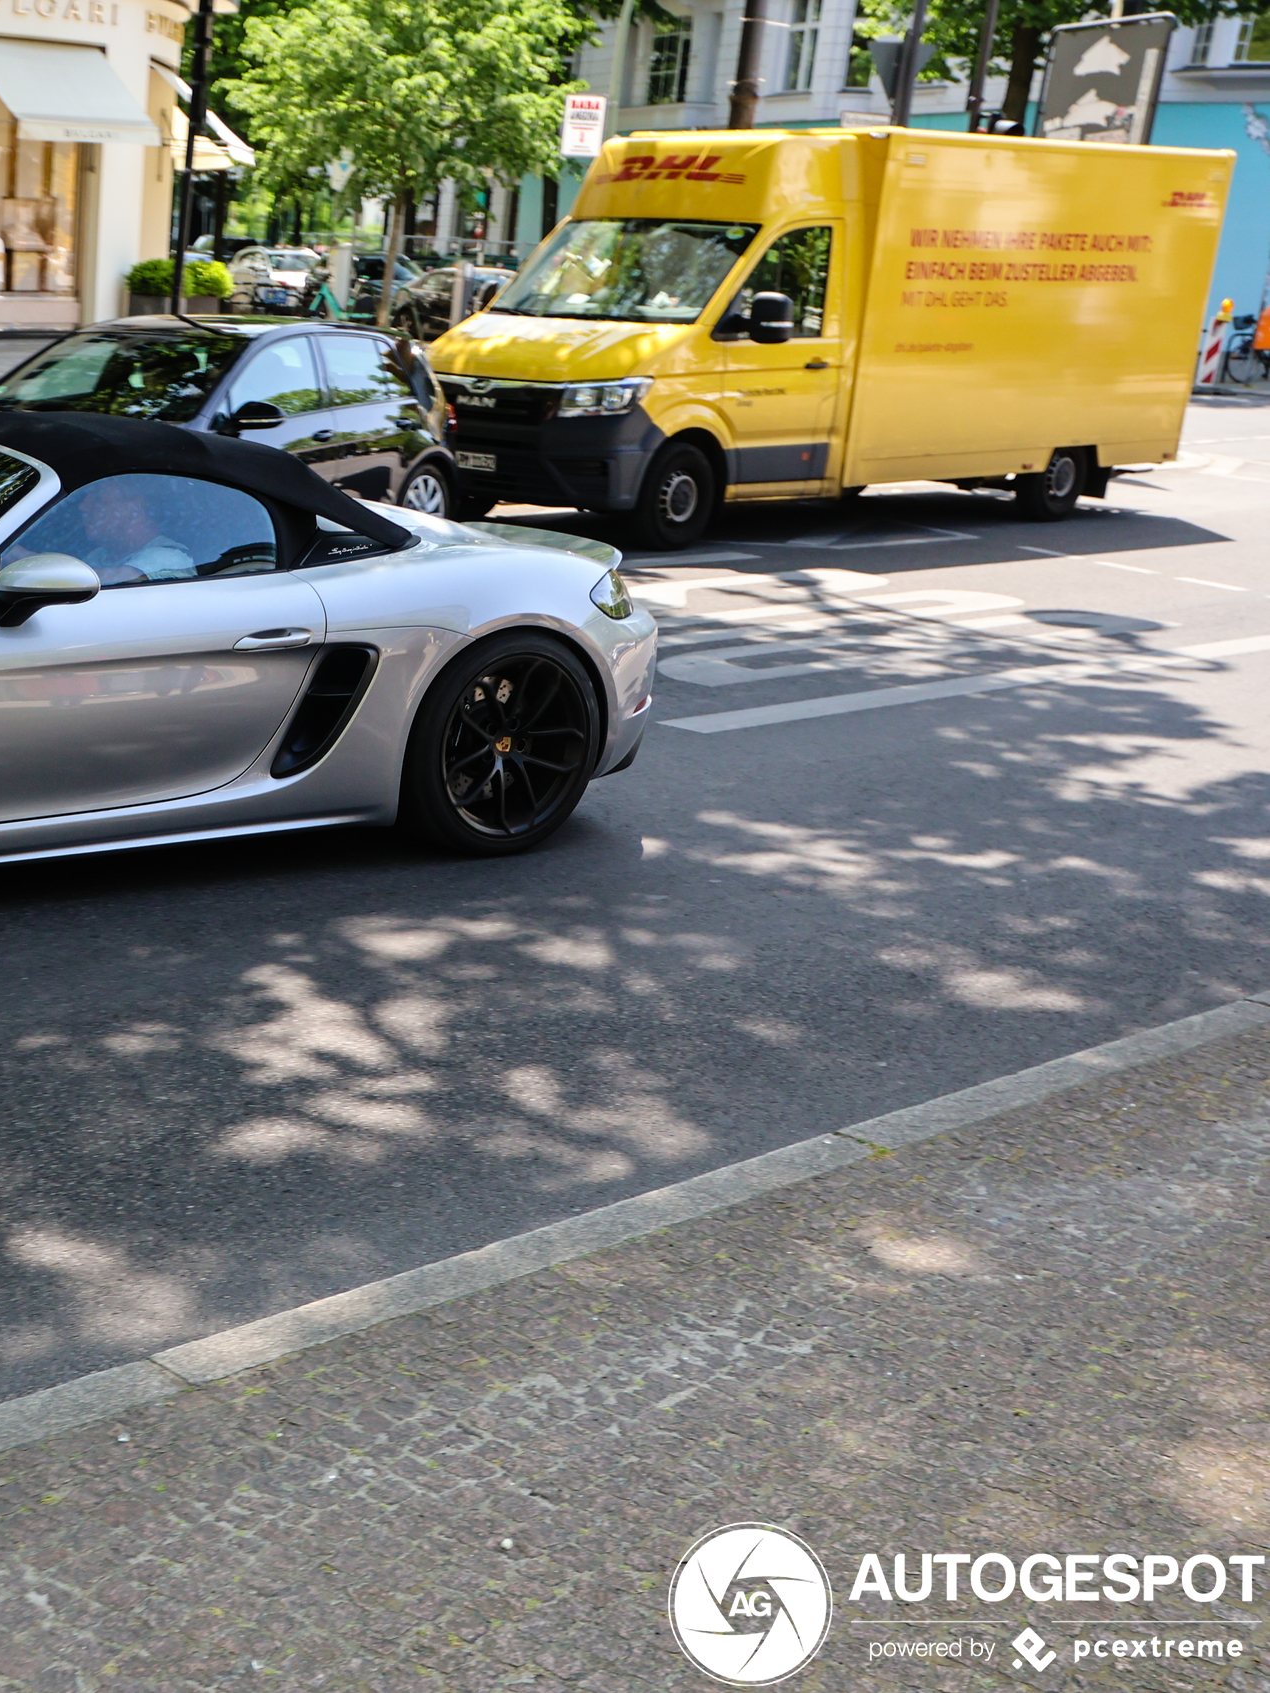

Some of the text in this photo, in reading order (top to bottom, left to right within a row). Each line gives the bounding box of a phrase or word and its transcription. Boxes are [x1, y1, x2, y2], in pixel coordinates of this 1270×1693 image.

[612, 155, 723, 182] DHL
[1168, 191, 1208, 208] DHL
[910, 228, 938, 248] WIR
[941, 229, 1001, 249] NEHMEN
[1004, 231, 1036, 251] IHRE
[1038, 232, 1089, 252] PAKETE
[1090, 233, 1125, 253] AUCH
[905, 261, 967, 280] EINFACH
[968, 261, 1003, 281] BEIM
[1004, 262, 1078, 281] ZUSTELLER
[901, 290, 924, 307] MIT
[925, 290, 949, 307] DHL
[951, 290, 983, 307] GEHT
[456, 394, 497, 408] MAN
